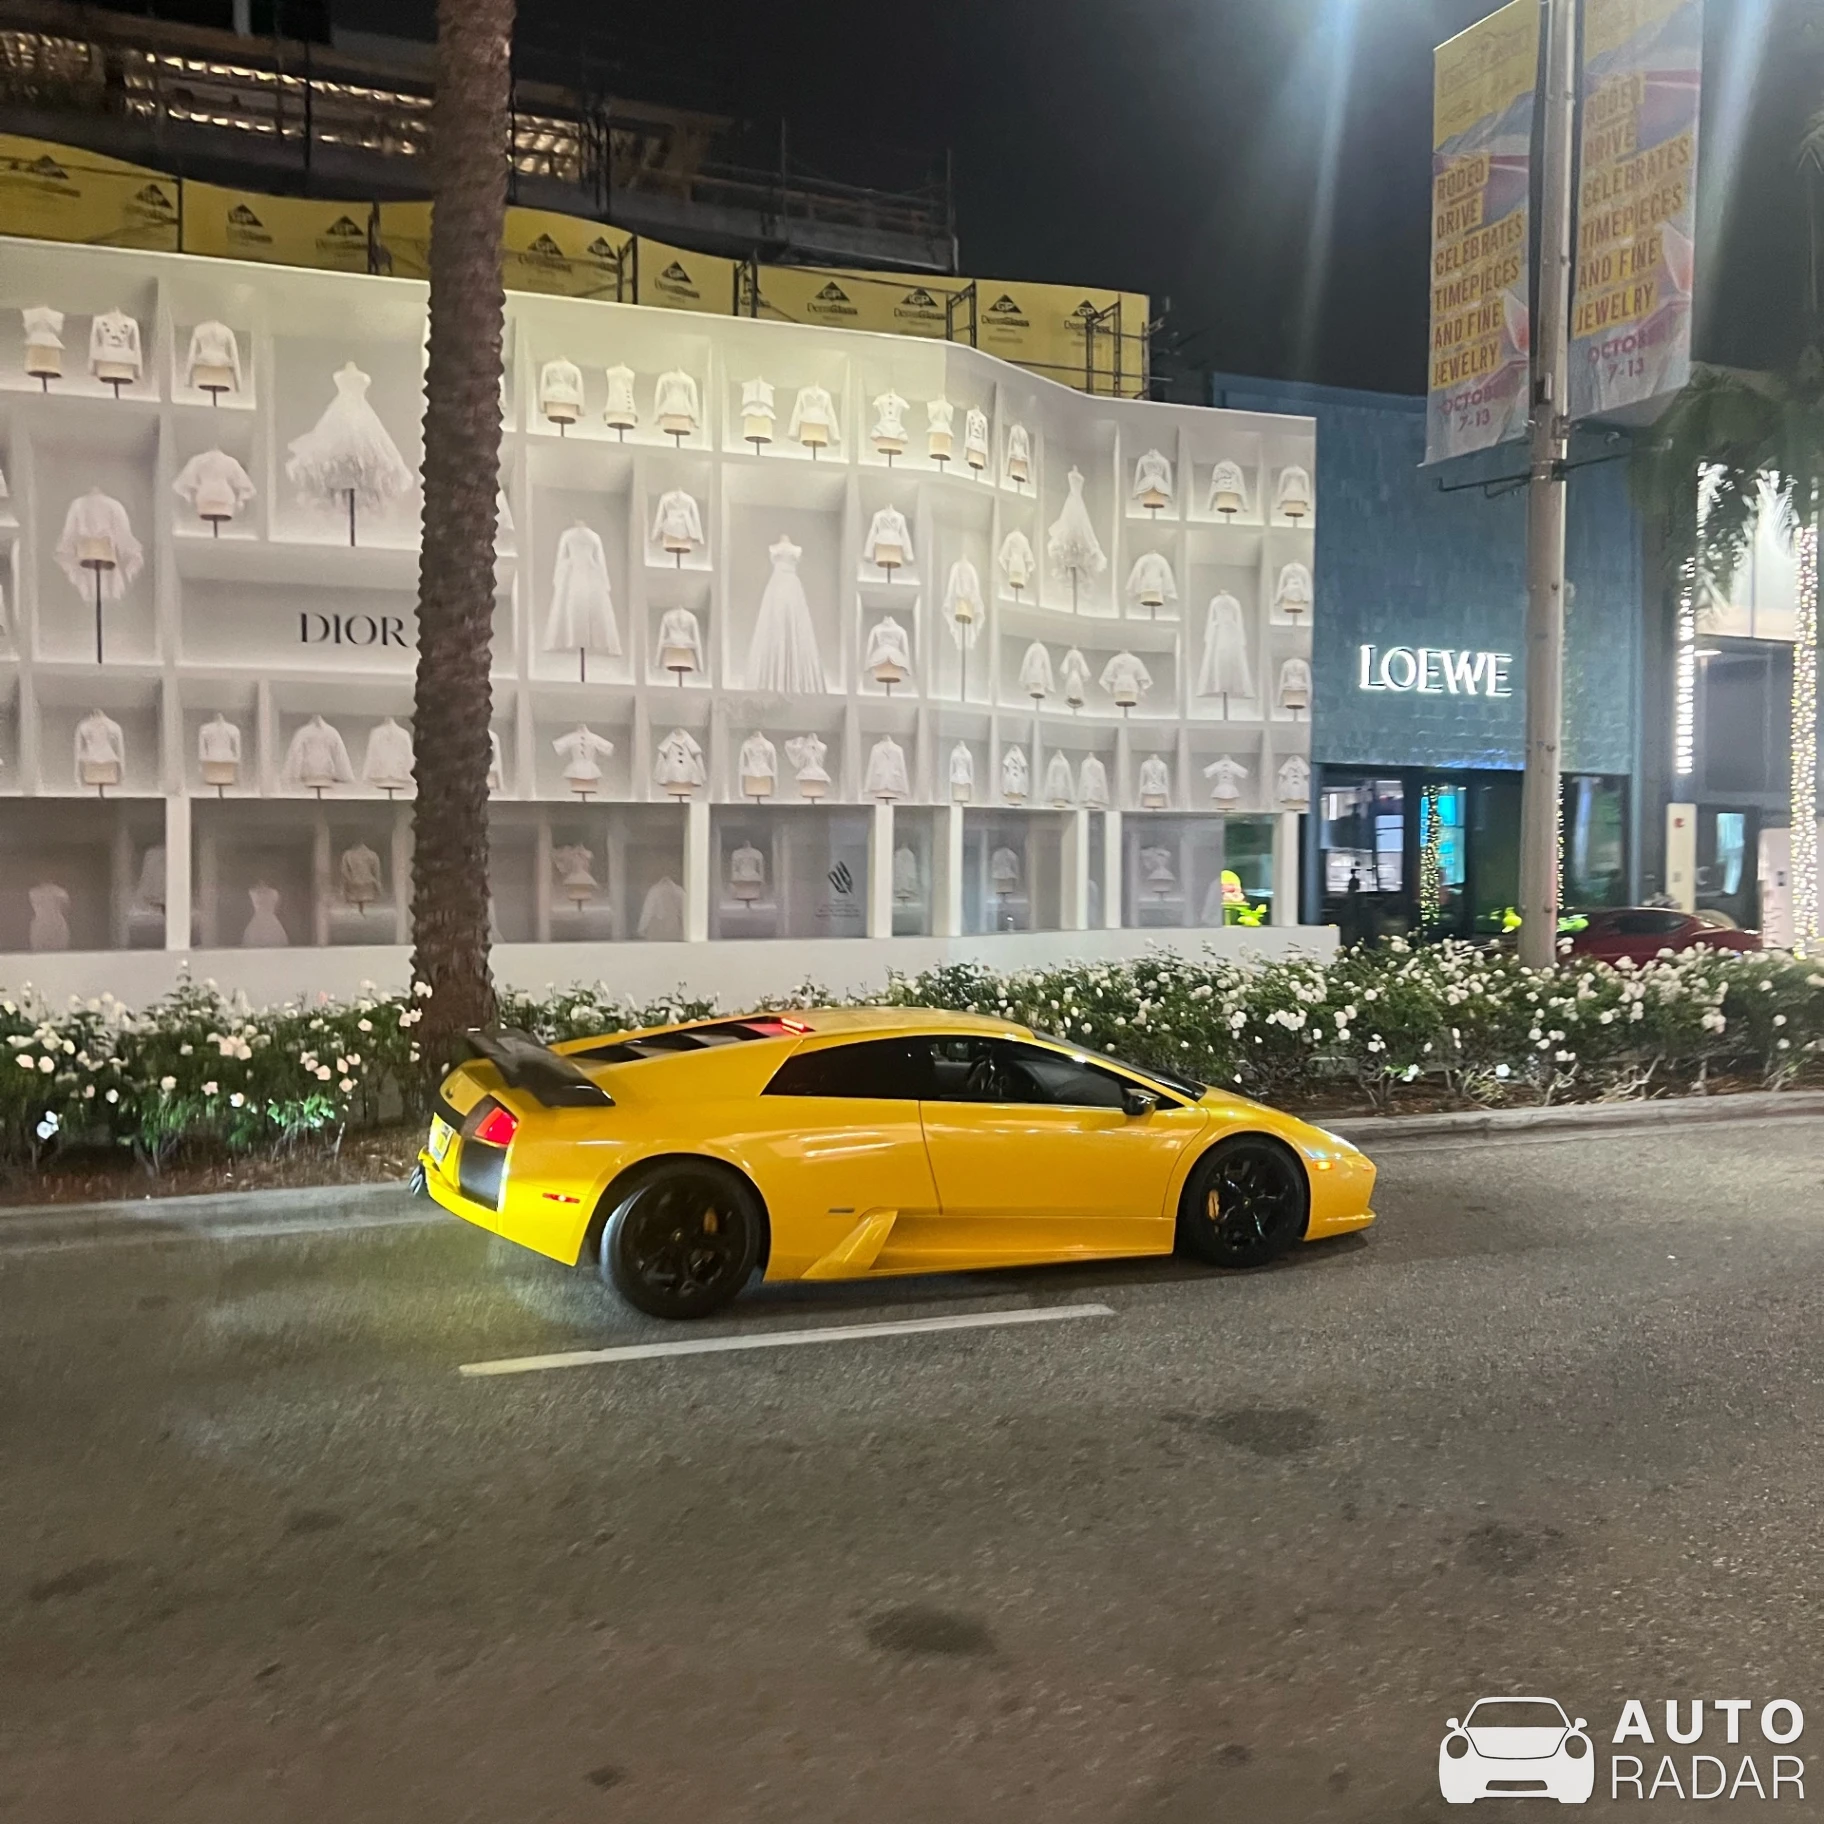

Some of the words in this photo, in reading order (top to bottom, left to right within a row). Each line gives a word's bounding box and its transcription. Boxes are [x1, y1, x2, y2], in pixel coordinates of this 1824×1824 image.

[1583, 123, 1634, 165] DRIVE
[1437, 158, 1485, 199] RODEO
[1583, 137, 1690, 208] CELEBRATES
[1436, 205, 1478, 240] DRIVE
[1581, 185, 1683, 248] TIMEPIECES
[1435, 213, 1523, 277] CELEBRATES
[1578, 254, 1611, 292] AND
[1619, 237, 1657, 279] FINE
[1435, 256, 1519, 312] TIMEPIECES
[1435, 317, 1463, 350] AND
[1468, 302, 1502, 340] FINE
[1577, 284, 1654, 331] JEWELRY
[1433, 342, 1498, 387] JEWELRY
[1587, 326, 1658, 365] OCTOB
[1607, 357, 1644, 383] 7-13
[1438, 380, 1502, 416] OCTOB
[1457, 408, 1491, 432] 7-13
[298, 612, 409, 648] DIOR
[1358, 644, 1513, 697] LOEWE
[1676, 645, 1694, 774] INTERNATIONAL
